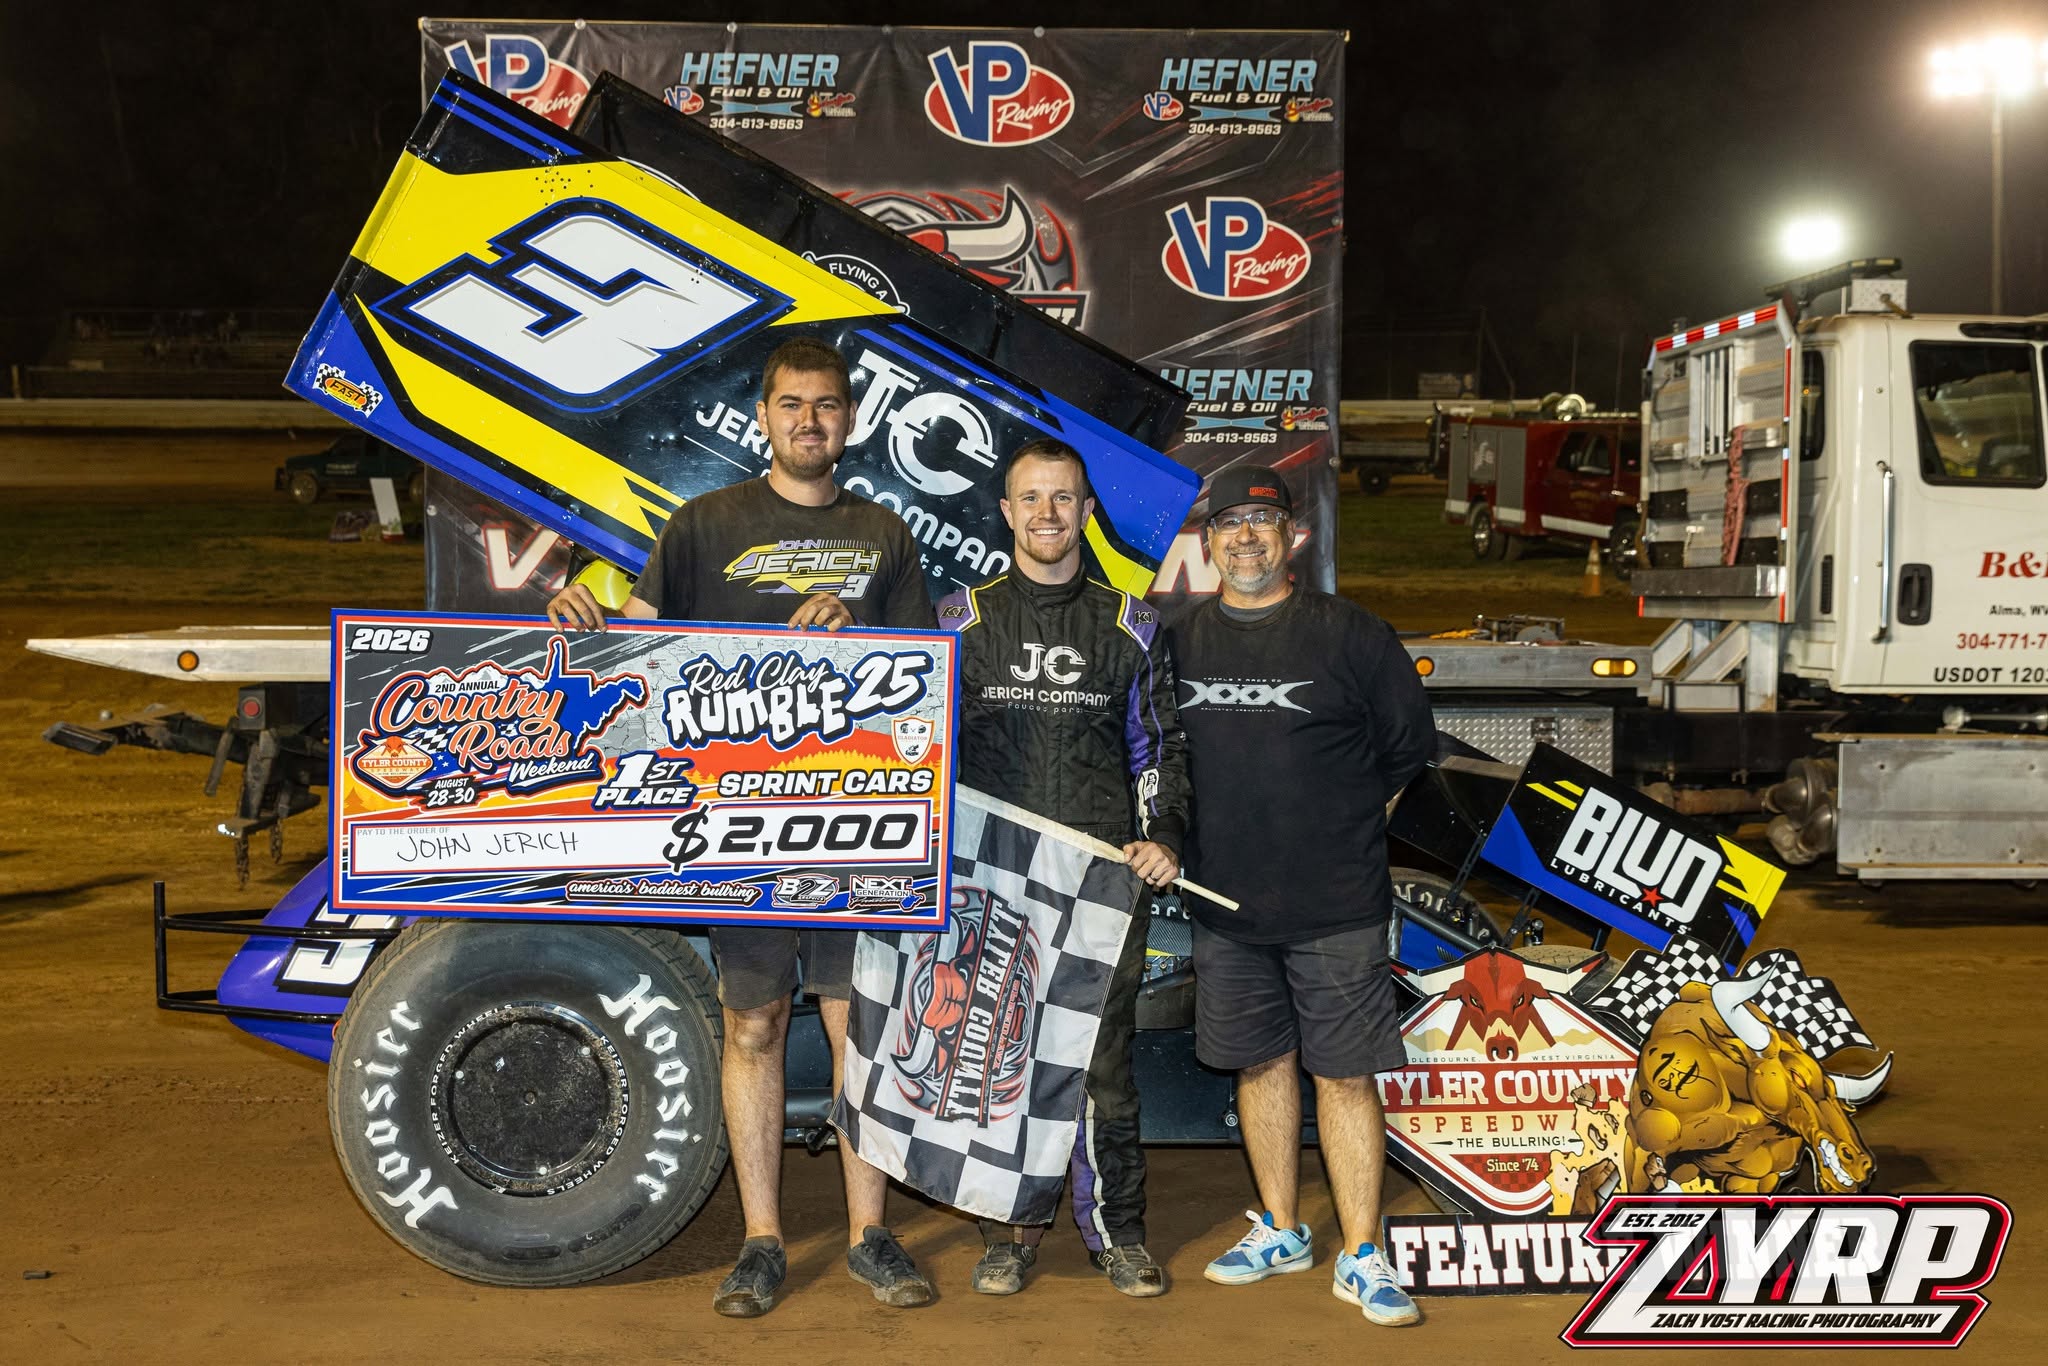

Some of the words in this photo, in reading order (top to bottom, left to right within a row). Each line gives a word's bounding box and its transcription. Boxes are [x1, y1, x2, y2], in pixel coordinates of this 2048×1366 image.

[680, 52, 839, 87] HEFNER
[1159, 58, 1317, 92] HEFNER
[710, 87, 752, 98] Fuel
[757, 87, 771, 98] &
[776, 87, 803, 98] Oil
[927, 41, 1031, 146] VP
[1144, 92, 1172, 121] VP
[1189, 92, 1231, 104] Fuel
[1236, 92, 1250, 104] &
[1255, 92, 1281, 104] Oil
[709, 118, 803, 130] 304-613-9563
[996, 96, 1072, 131] Racing
[1189, 123, 1281, 135] 304-613-9563
[1165, 197, 1268, 301] VP
[829, 263, 880, 289] FLYING
[875, 289, 888, 301] A
[1234, 253, 1309, 289] Racing
[405, 213, 760, 396] 3
[329, 379, 366, 402] FAST
[1160, 368, 1313, 401] HEFNER
[1186, 402, 1226, 412] Fuel
[1231, 402, 1247, 412] &
[1251, 402, 1277, 412] Oil
[1184, 433, 1277, 443] 304-613-9563
[843, 476, 1012, 577] COMPAN
[773, 539, 822, 551] JOHN
[730, 551, 881, 579] JERICH
[1977, 551, 2048, 578] B&
[838, 574, 875, 600] 3
[351, 629, 430, 651] 2026
[683, 658, 748, 696] Red
[756, 655, 830, 691] Clay
[1010, 643, 1086, 685] JC
[1934, 667, 2002, 683] USDOT
[2009, 667, 2048, 683] 120
[435, 684, 456, 693] 2ND
[459, 680, 501, 691] ANNUAL
[667, 677, 847, 743] RUMBLE
[846, 655, 927, 712] 25
[981, 686, 1034, 700] JERICH
[1037, 689, 1111, 706] COMPANY
[380, 678, 565, 735] Country
[448, 719, 572, 769] Roads
[361, 759, 391, 767] TYLER
[392, 759, 428, 767] COUNTY
[508, 752, 595, 784] Weekend
[427, 788, 475, 807] 28-30
[434, 777, 468, 790] AUGUST
[594, 786, 694, 806] PLACE
[719, 771, 840, 796] SPRINT
[844, 770, 933, 793] CARS
[407, 827, 436, 835] ORDER
[663, 804, 919, 873] $2,000
[396, 833, 471, 862] JOHN
[486, 831, 579, 855] JERICH
[1554, 786, 1723, 924] BLUD
[568, 881, 635, 894] america's
[638, 880, 699, 896] baddest
[700, 882, 758, 902] bullring
[852, 877, 907, 891] NEXT
[1550, 857, 1692, 936] LUBRICANTS
[599, 1035, 628, 1088] KEIZER
[597, 973, 703, 1203] Hoosier
[1374, 1070, 1488, 1106] TYLER
[1494, 1067, 1637, 1105] COUNTY
[353, 1000, 460, 1230] Hoosier
[605, 1093, 629, 1156] FORGED
[1410, 1114, 1577, 1134] SPEEDW
[1457, 1137, 1483, 1148] THE
[1492, 1135, 1566, 1148] BULLRING!
[547, 1159, 605, 1196] WHEELS
[1486, 1158, 1520, 1172] Since
[1522, 1157, 1539, 1171] '74
